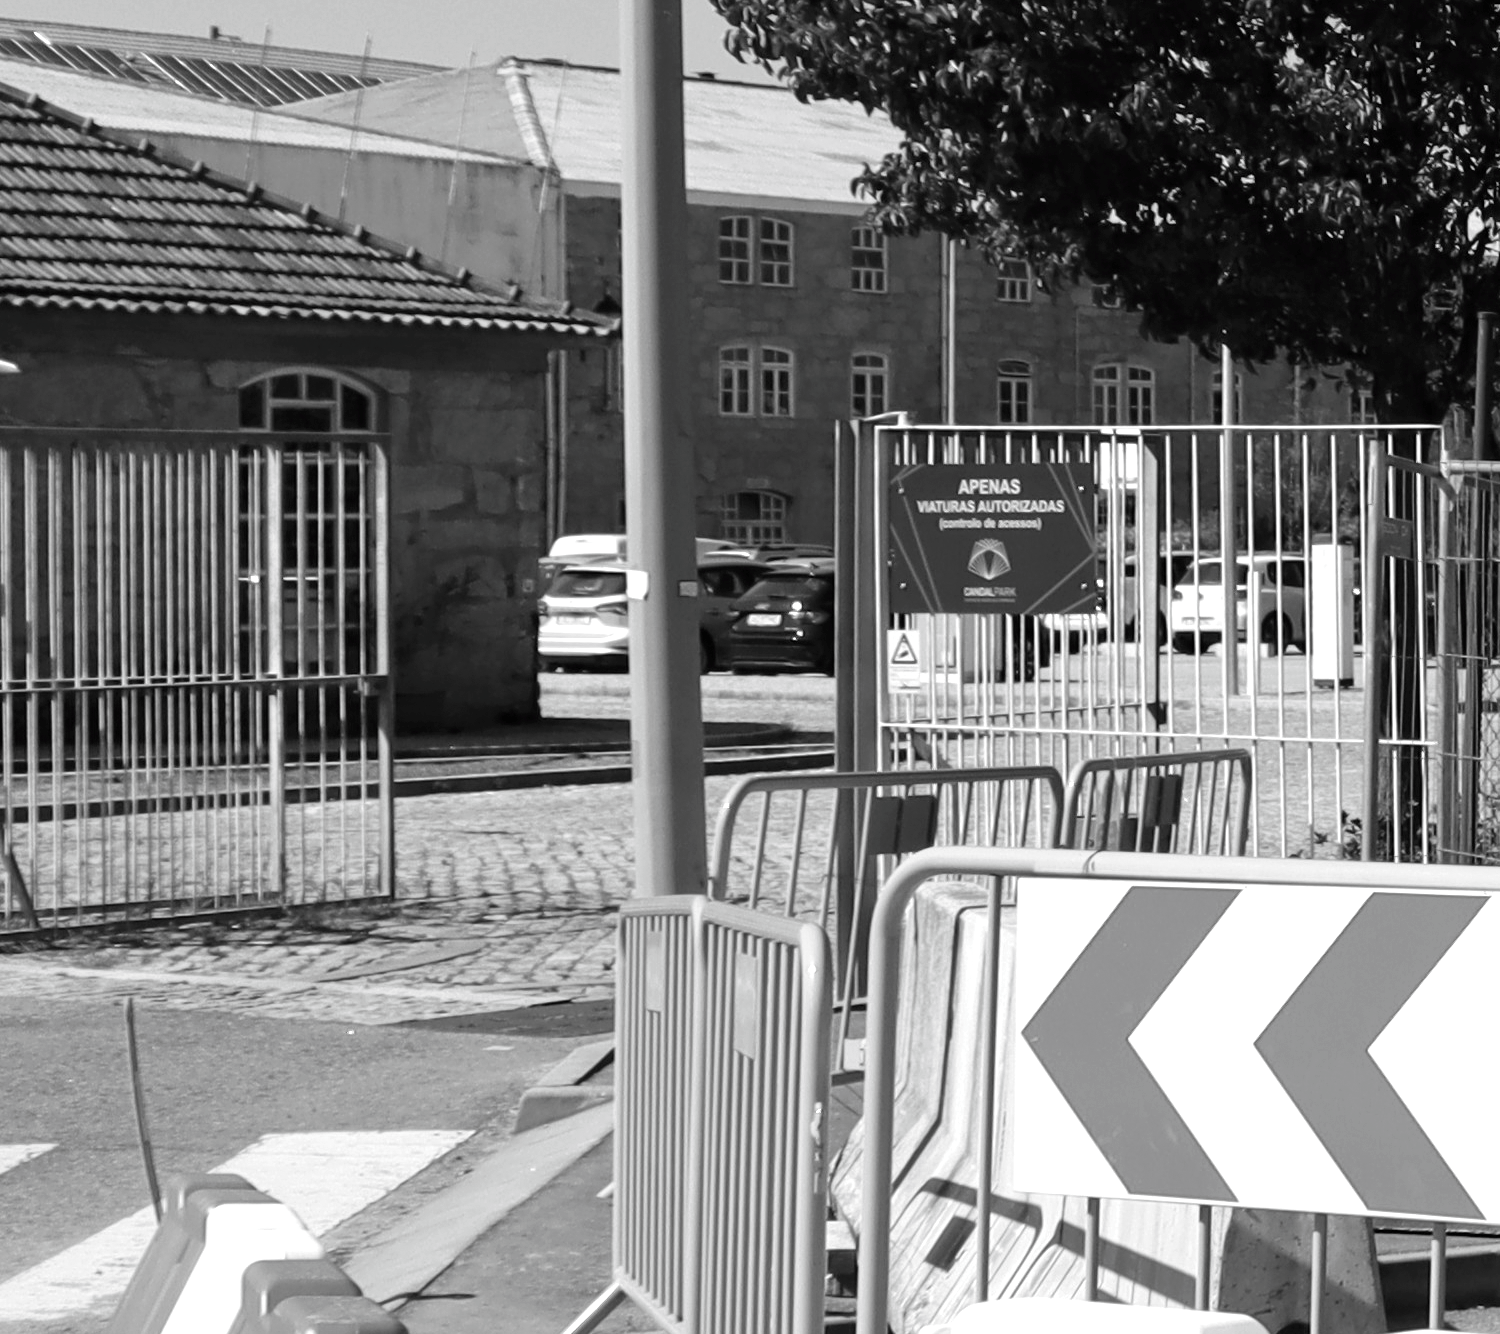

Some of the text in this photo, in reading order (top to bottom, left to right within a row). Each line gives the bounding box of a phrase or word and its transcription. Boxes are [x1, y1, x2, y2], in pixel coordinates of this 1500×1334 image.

[958, 478, 1021, 495] APENAS
[917, 500, 1066, 514] VIATURAS AUTORIZADAS
[984, 517, 996, 529] de
